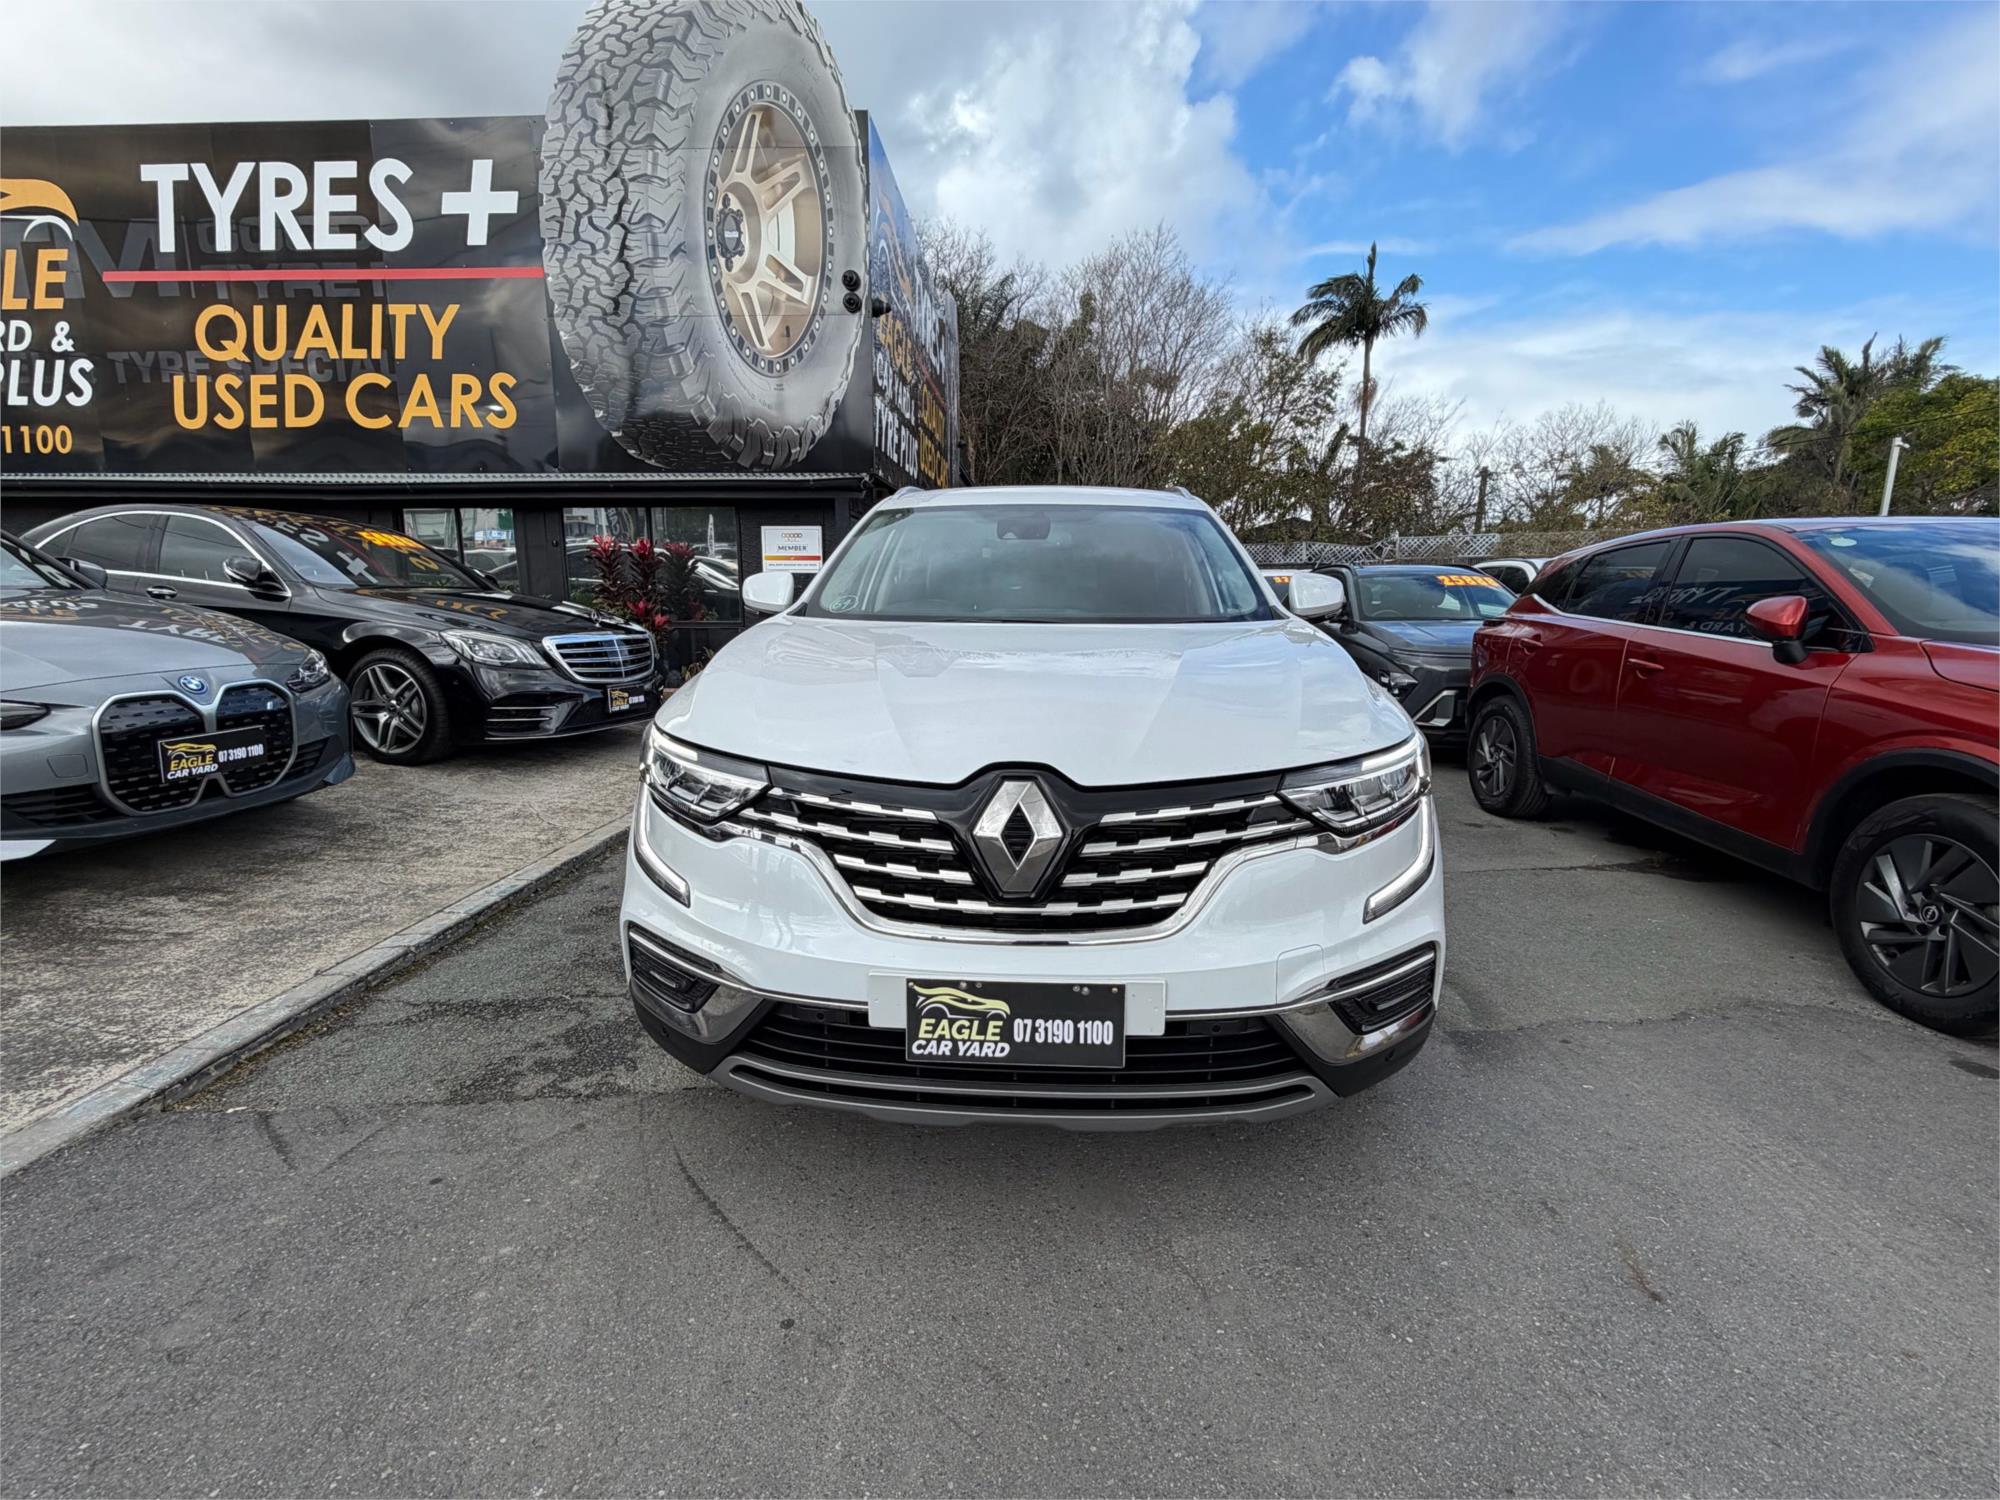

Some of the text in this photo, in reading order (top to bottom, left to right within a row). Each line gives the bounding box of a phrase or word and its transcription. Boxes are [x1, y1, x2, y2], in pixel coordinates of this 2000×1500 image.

[140, 158, 414, 252] TYRES
[0, 319, 75, 352] D &
[195, 304, 460, 361] QUALITY
[0, 358, 94, 407] LUS
[876, 351, 893, 401] CAR
[894, 373, 911, 419] YARD
[173, 372, 518, 429] USED CARS
[1, 425, 73, 454] 1100
[875, 396, 919, 480] TYRE PLUS
[170, 754, 214, 771] EAGLE
[218, 743, 264, 762] 07 3190 1100
[167, 763, 219, 780] CAR YARD
[918, 1018, 1003, 1041] EAGLE
[1013, 1018, 1114, 1045] 07 3190 1100
[911, 1039, 1010, 1057] CAR YARD
